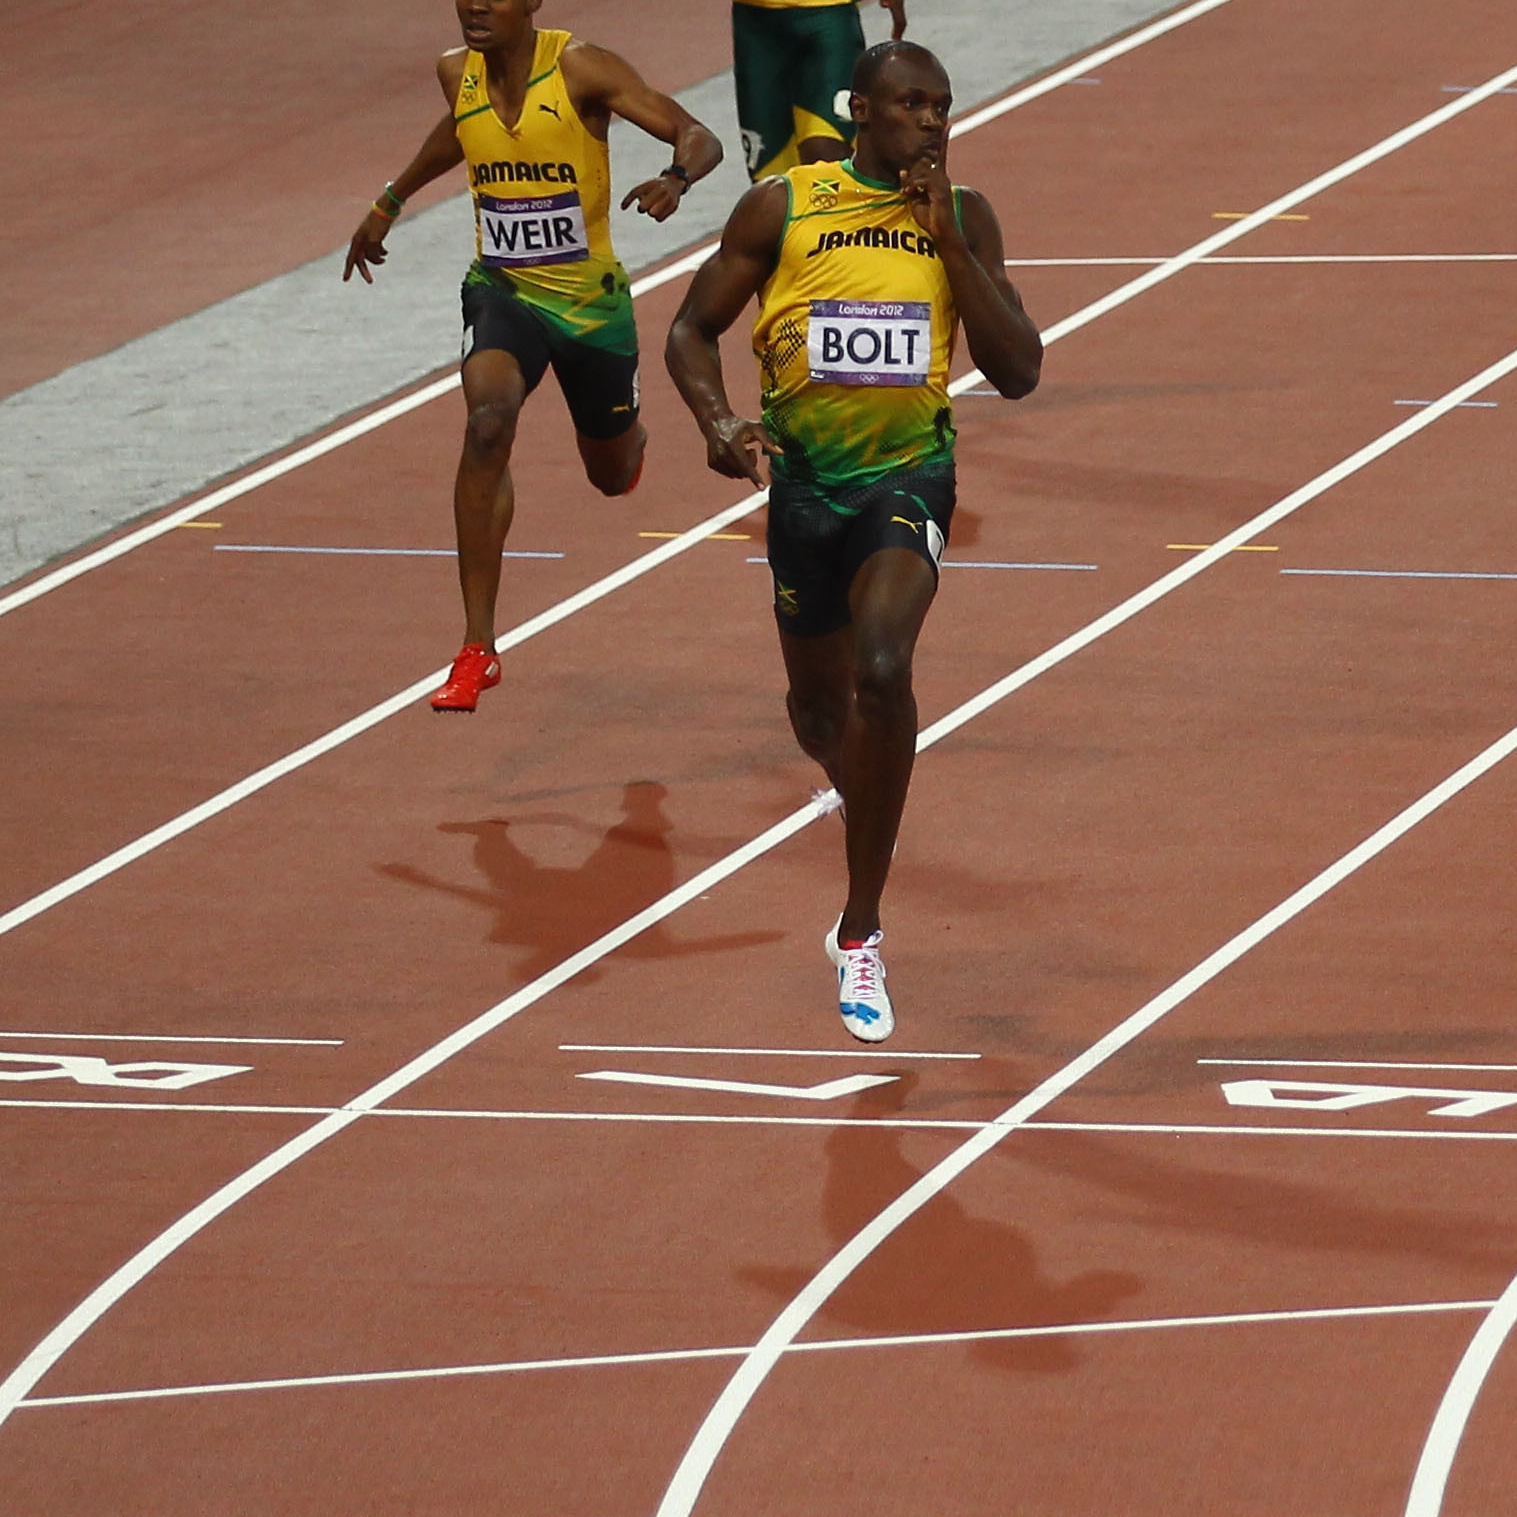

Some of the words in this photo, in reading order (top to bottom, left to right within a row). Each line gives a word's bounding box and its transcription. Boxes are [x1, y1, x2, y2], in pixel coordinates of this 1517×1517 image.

[473, 161, 577, 186] JAMAICA
[496, 200, 529, 211] London
[530, 198, 553, 210] 2012
[486, 216, 579, 252] WEIR
[806, 225, 936, 260] JAMAICA
[838, 303, 878, 316] London
[879, 304, 904, 316] 2012
[822, 326, 921, 366] BOLT
[575, 1070, 901, 1101] 7
